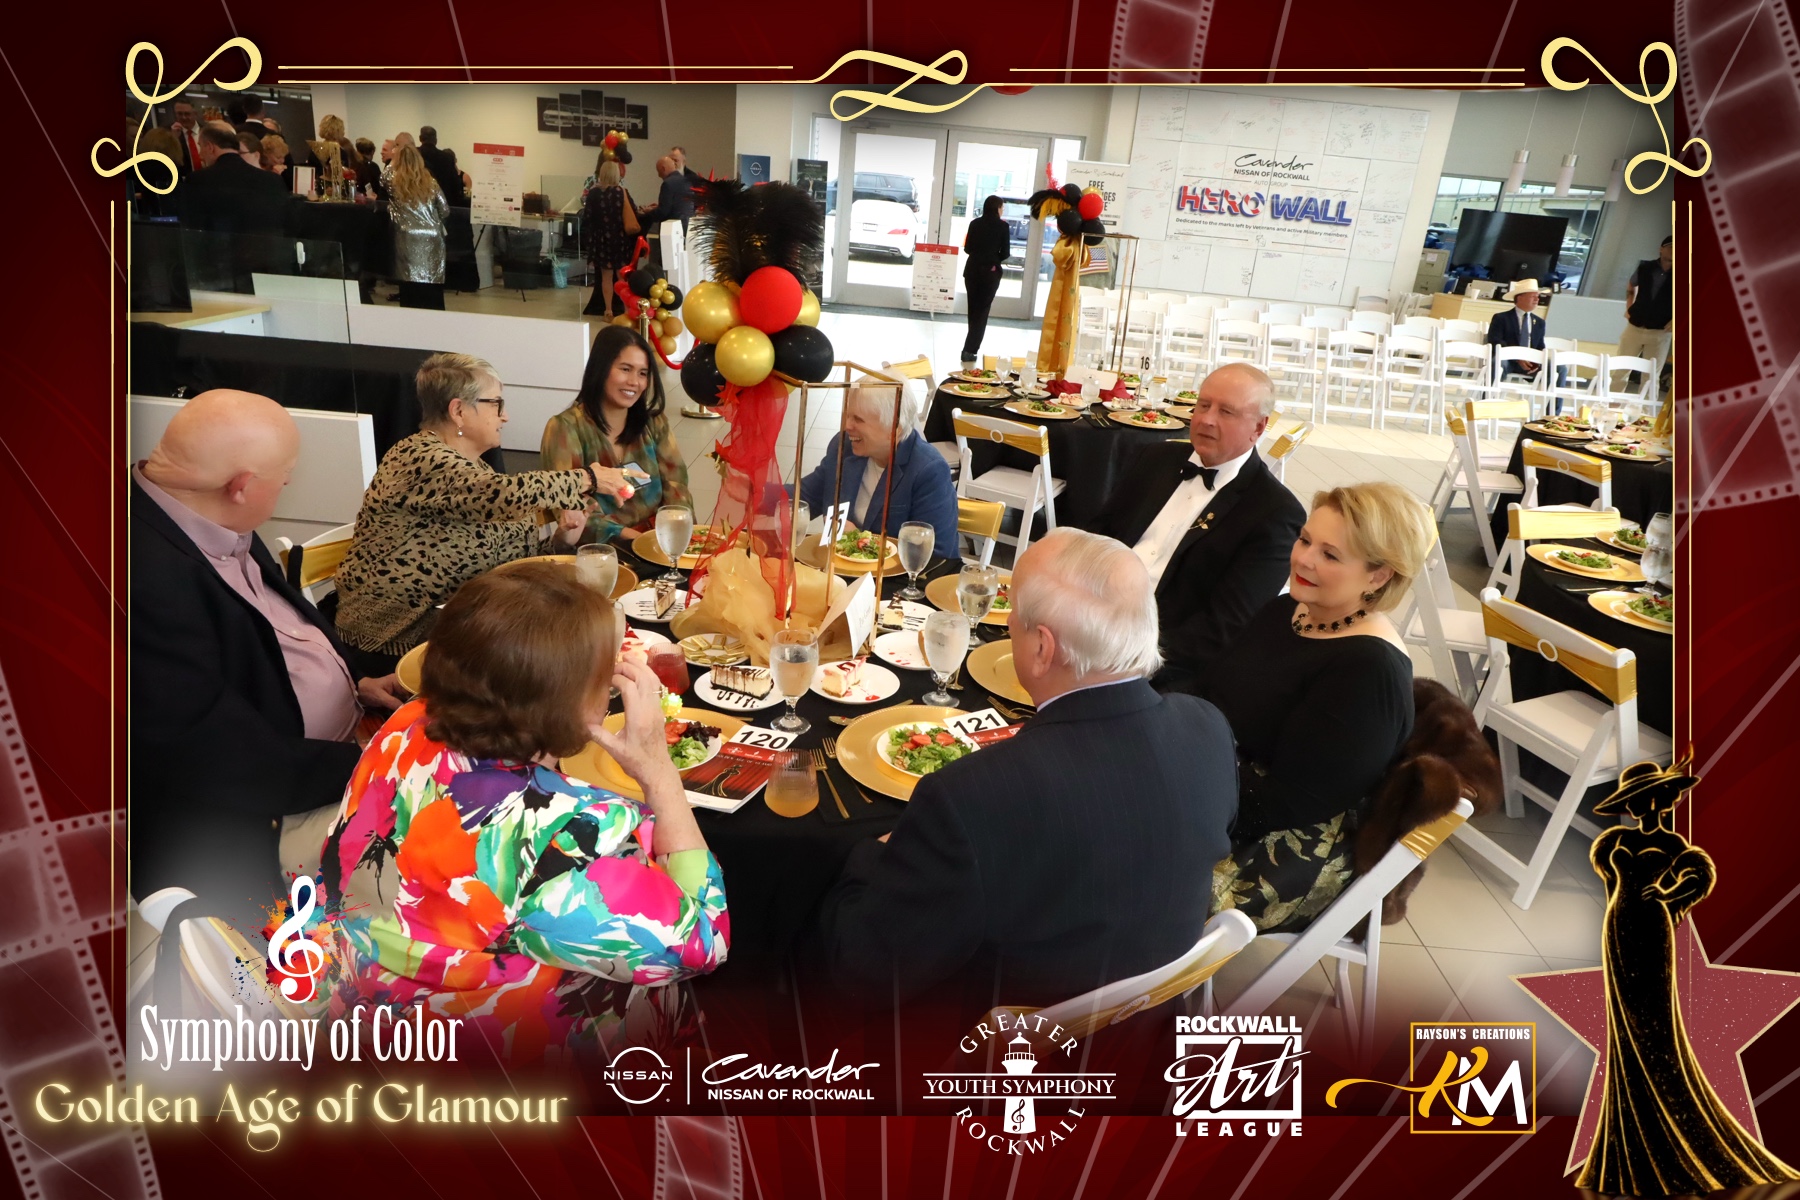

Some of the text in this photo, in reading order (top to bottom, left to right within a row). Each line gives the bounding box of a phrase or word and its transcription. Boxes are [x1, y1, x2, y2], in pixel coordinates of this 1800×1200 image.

[1235, 153, 1314, 170] Cavender
[1233, 168, 1260, 177] NISSAN
[1272, 172, 1310, 181] ROCKWALL
[1088, 180, 1105, 191] FREE
[1177, 185, 1353, 226] HERO WALL
[1175, 217, 1202, 225] Dedicated
[1302, 229, 1323, 237] Military
[1140, 356, 1150, 370] 16
[953, 713, 1001, 736] 121
[740, 730, 788, 749] 120
